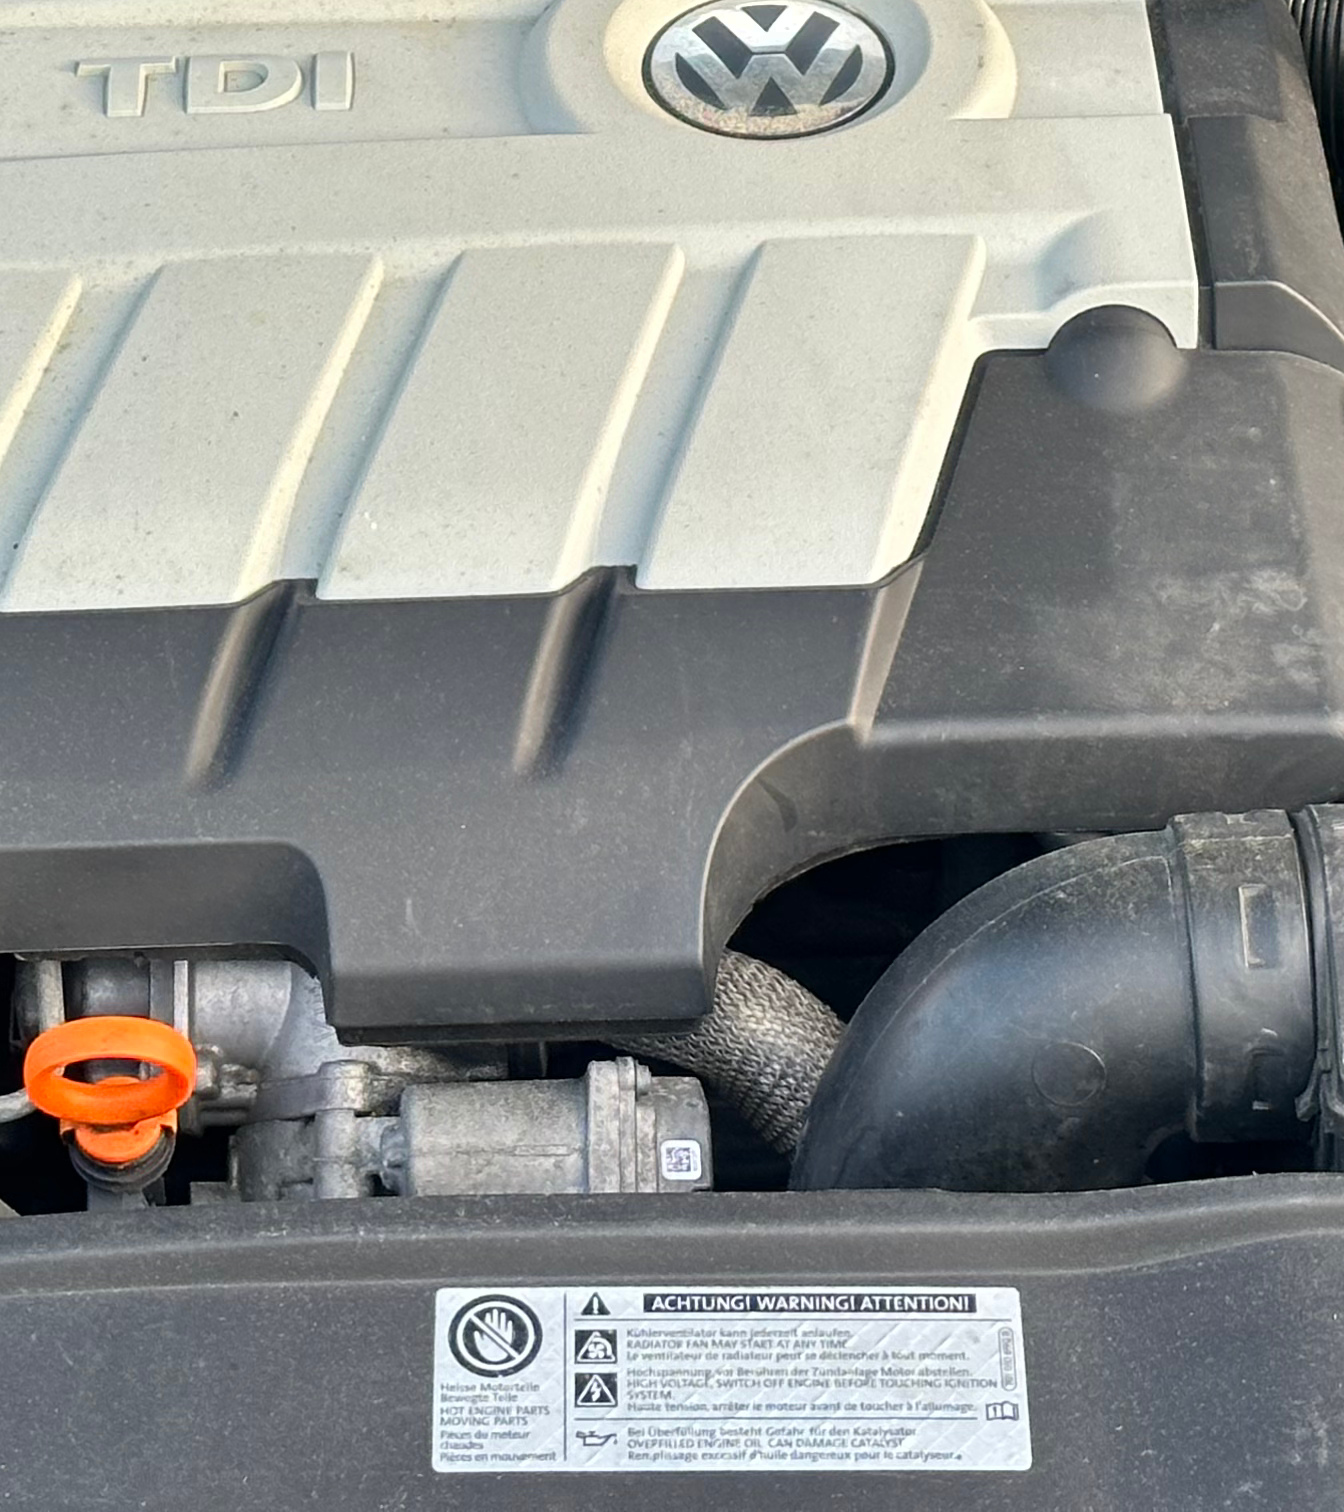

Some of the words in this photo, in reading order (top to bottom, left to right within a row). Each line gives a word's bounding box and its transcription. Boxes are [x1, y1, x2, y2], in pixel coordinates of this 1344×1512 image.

[76, 51, 354, 117] TDI
[651, 1296, 750, 1311] ACHTUNG!
[756, 1296, 855, 1311] WARNING!
[860, 1296, 969, 1311] ATTENTION!
[440, 1406, 464, 1415] HOT
[468, 1406, 512, 1415] ENGINE
[516, 1406, 550, 1415] PARTS
[440, 1417, 489, 1426] MOVING
[494, 1417, 528, 1426] PARTS
